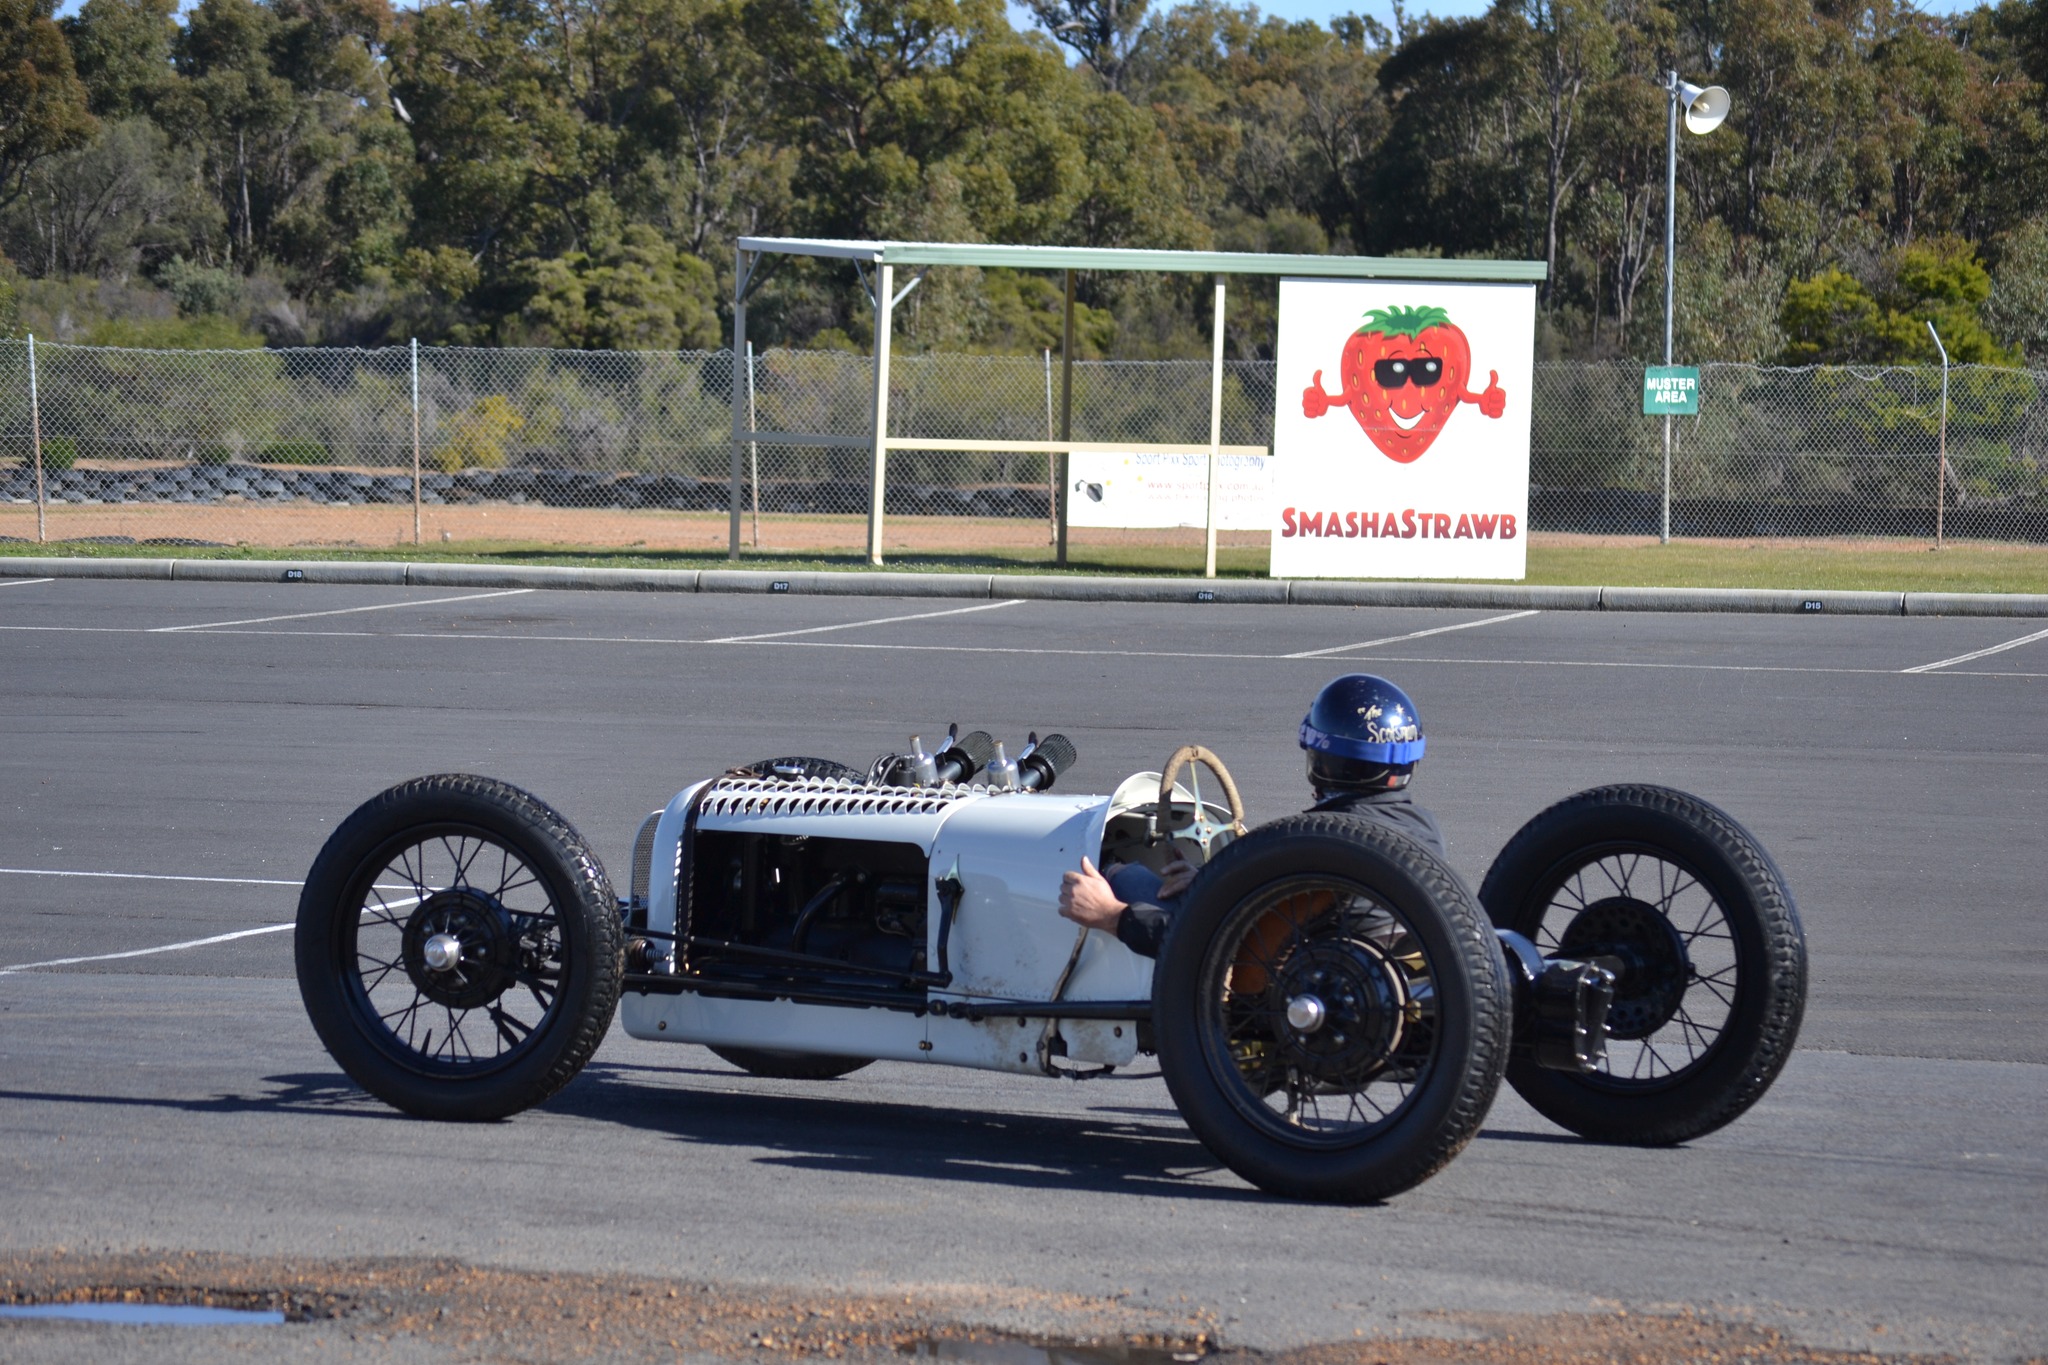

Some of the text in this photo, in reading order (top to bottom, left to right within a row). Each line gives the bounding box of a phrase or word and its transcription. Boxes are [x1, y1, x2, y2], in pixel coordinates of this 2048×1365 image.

[1646, 377, 1696, 391] MUSTER
[1655, 391, 1688, 403] AREA
[773, 582, 789, 590] D17
